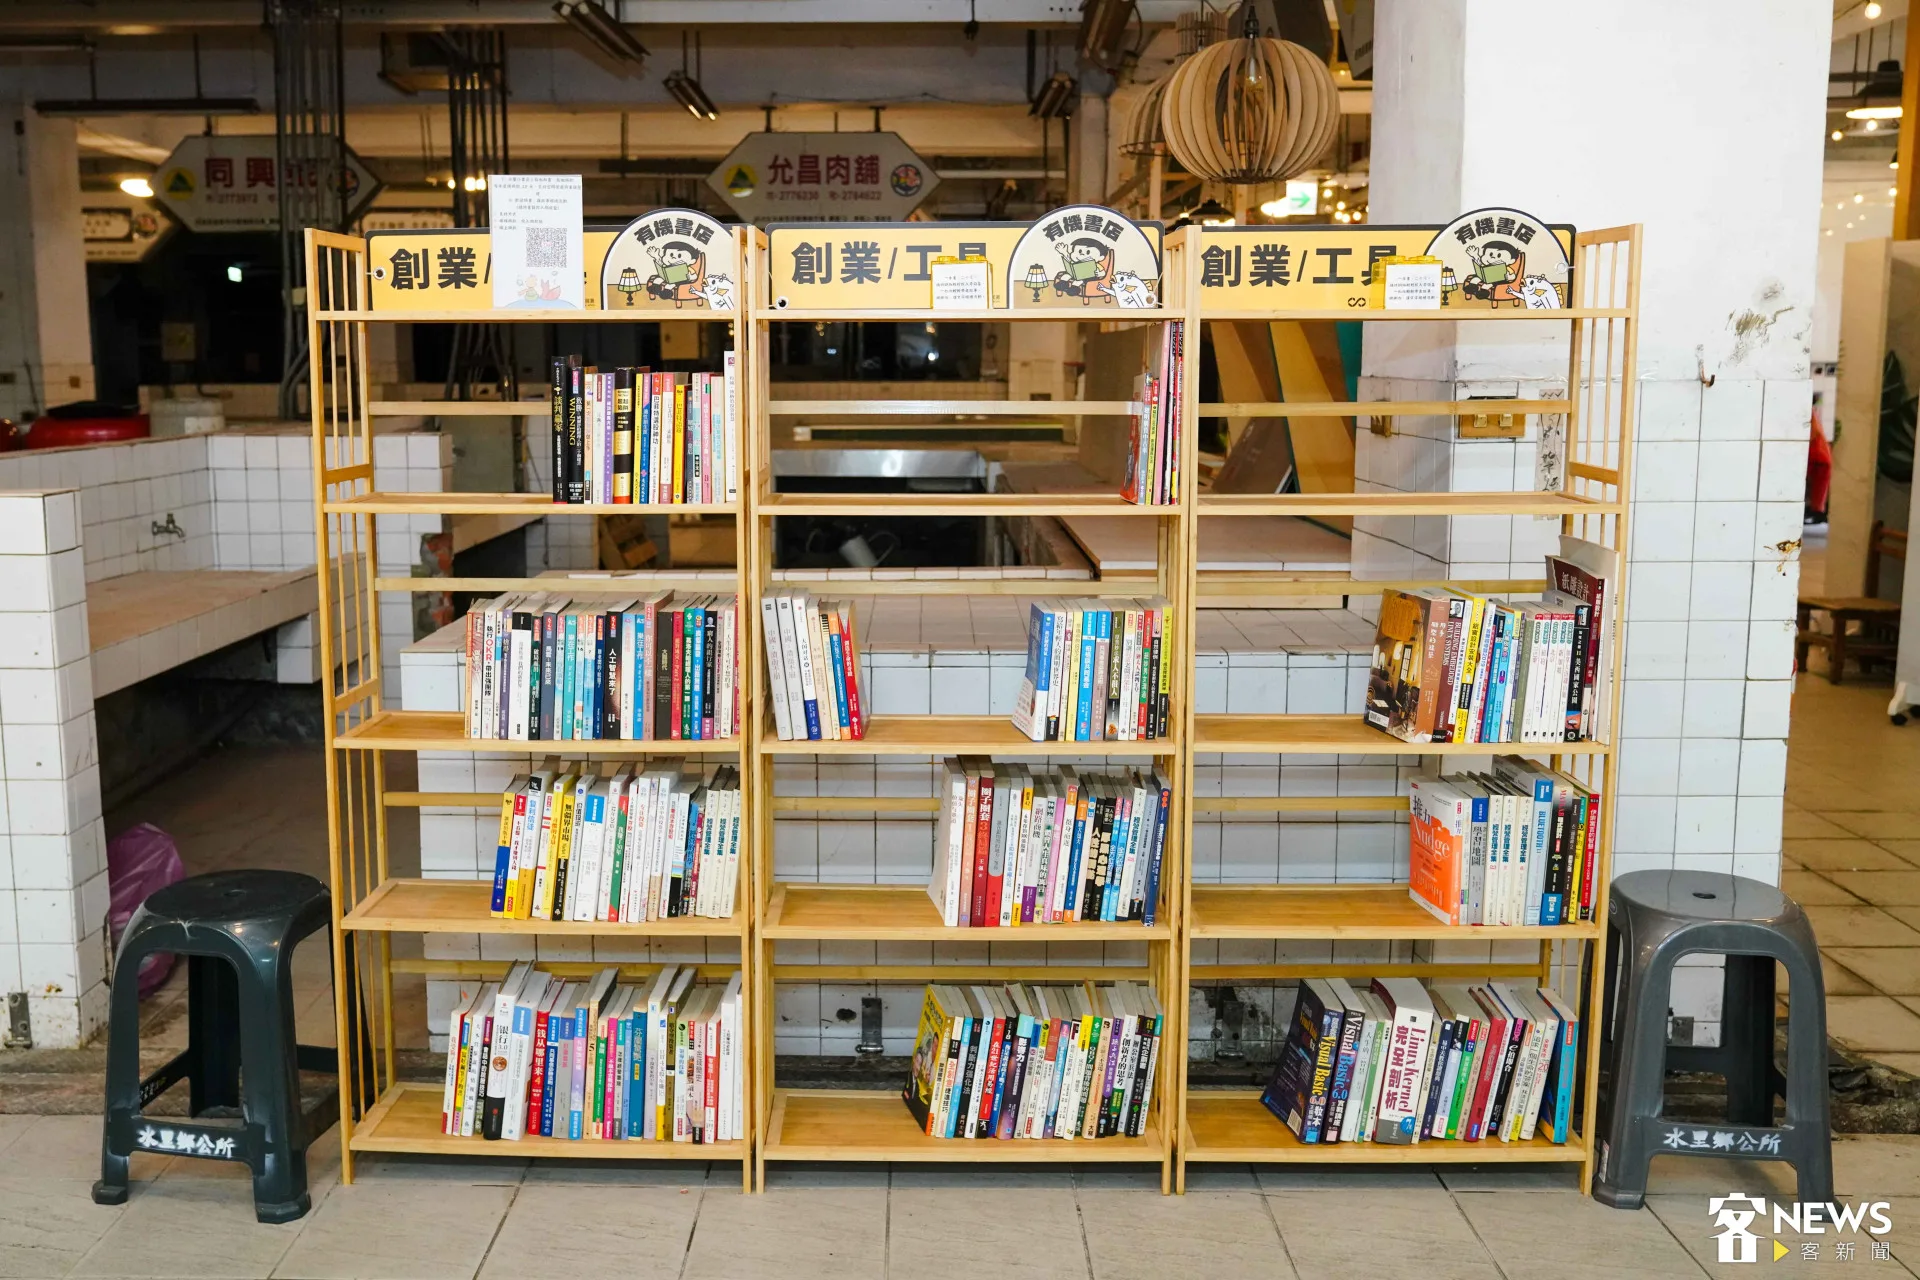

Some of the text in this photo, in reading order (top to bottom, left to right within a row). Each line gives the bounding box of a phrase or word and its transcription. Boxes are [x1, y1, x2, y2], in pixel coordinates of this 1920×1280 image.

[767, 154, 880, 185] 允昌肉舖
[633, 217, 715, 247] 有機書店
[1042, 213, 1125, 243] 有機書店
[1454, 216, 1537, 247] 有機書店
[1443, 642, 1451, 666] SYSTEMS
[1447, 622, 1461, 686] BUILDING EMBEDDED
[608, 648, 617, 696] 人工智慧來了
[979, 787, 992, 821] 圈子圈套
[1412, 796, 1431, 826] 推力
[1413, 815, 1450, 862] Nudge
[1472, 826, 1482, 867] 學習地圖
[1536, 811, 1547, 849] BLUETOOTH
[535, 1029, 546, 1076] 钱从哪里来
[1015, 1038, 1028, 1062] 影響力
[1116, 1037, 1131, 1086] 創新者的思考
[1331, 1016, 1363, 1100] Visual Basic 6.0
[1309, 1036, 1337, 1105] Visual Basic 6.0
[1398, 1027, 1427, 1114] Linux Kernel
[1312, 1106, 1325, 1127] 教本
[137, 1124, 236, 1158] 水里鄉公所
[1663, 1127, 1783, 1155] 水里鄉公所
